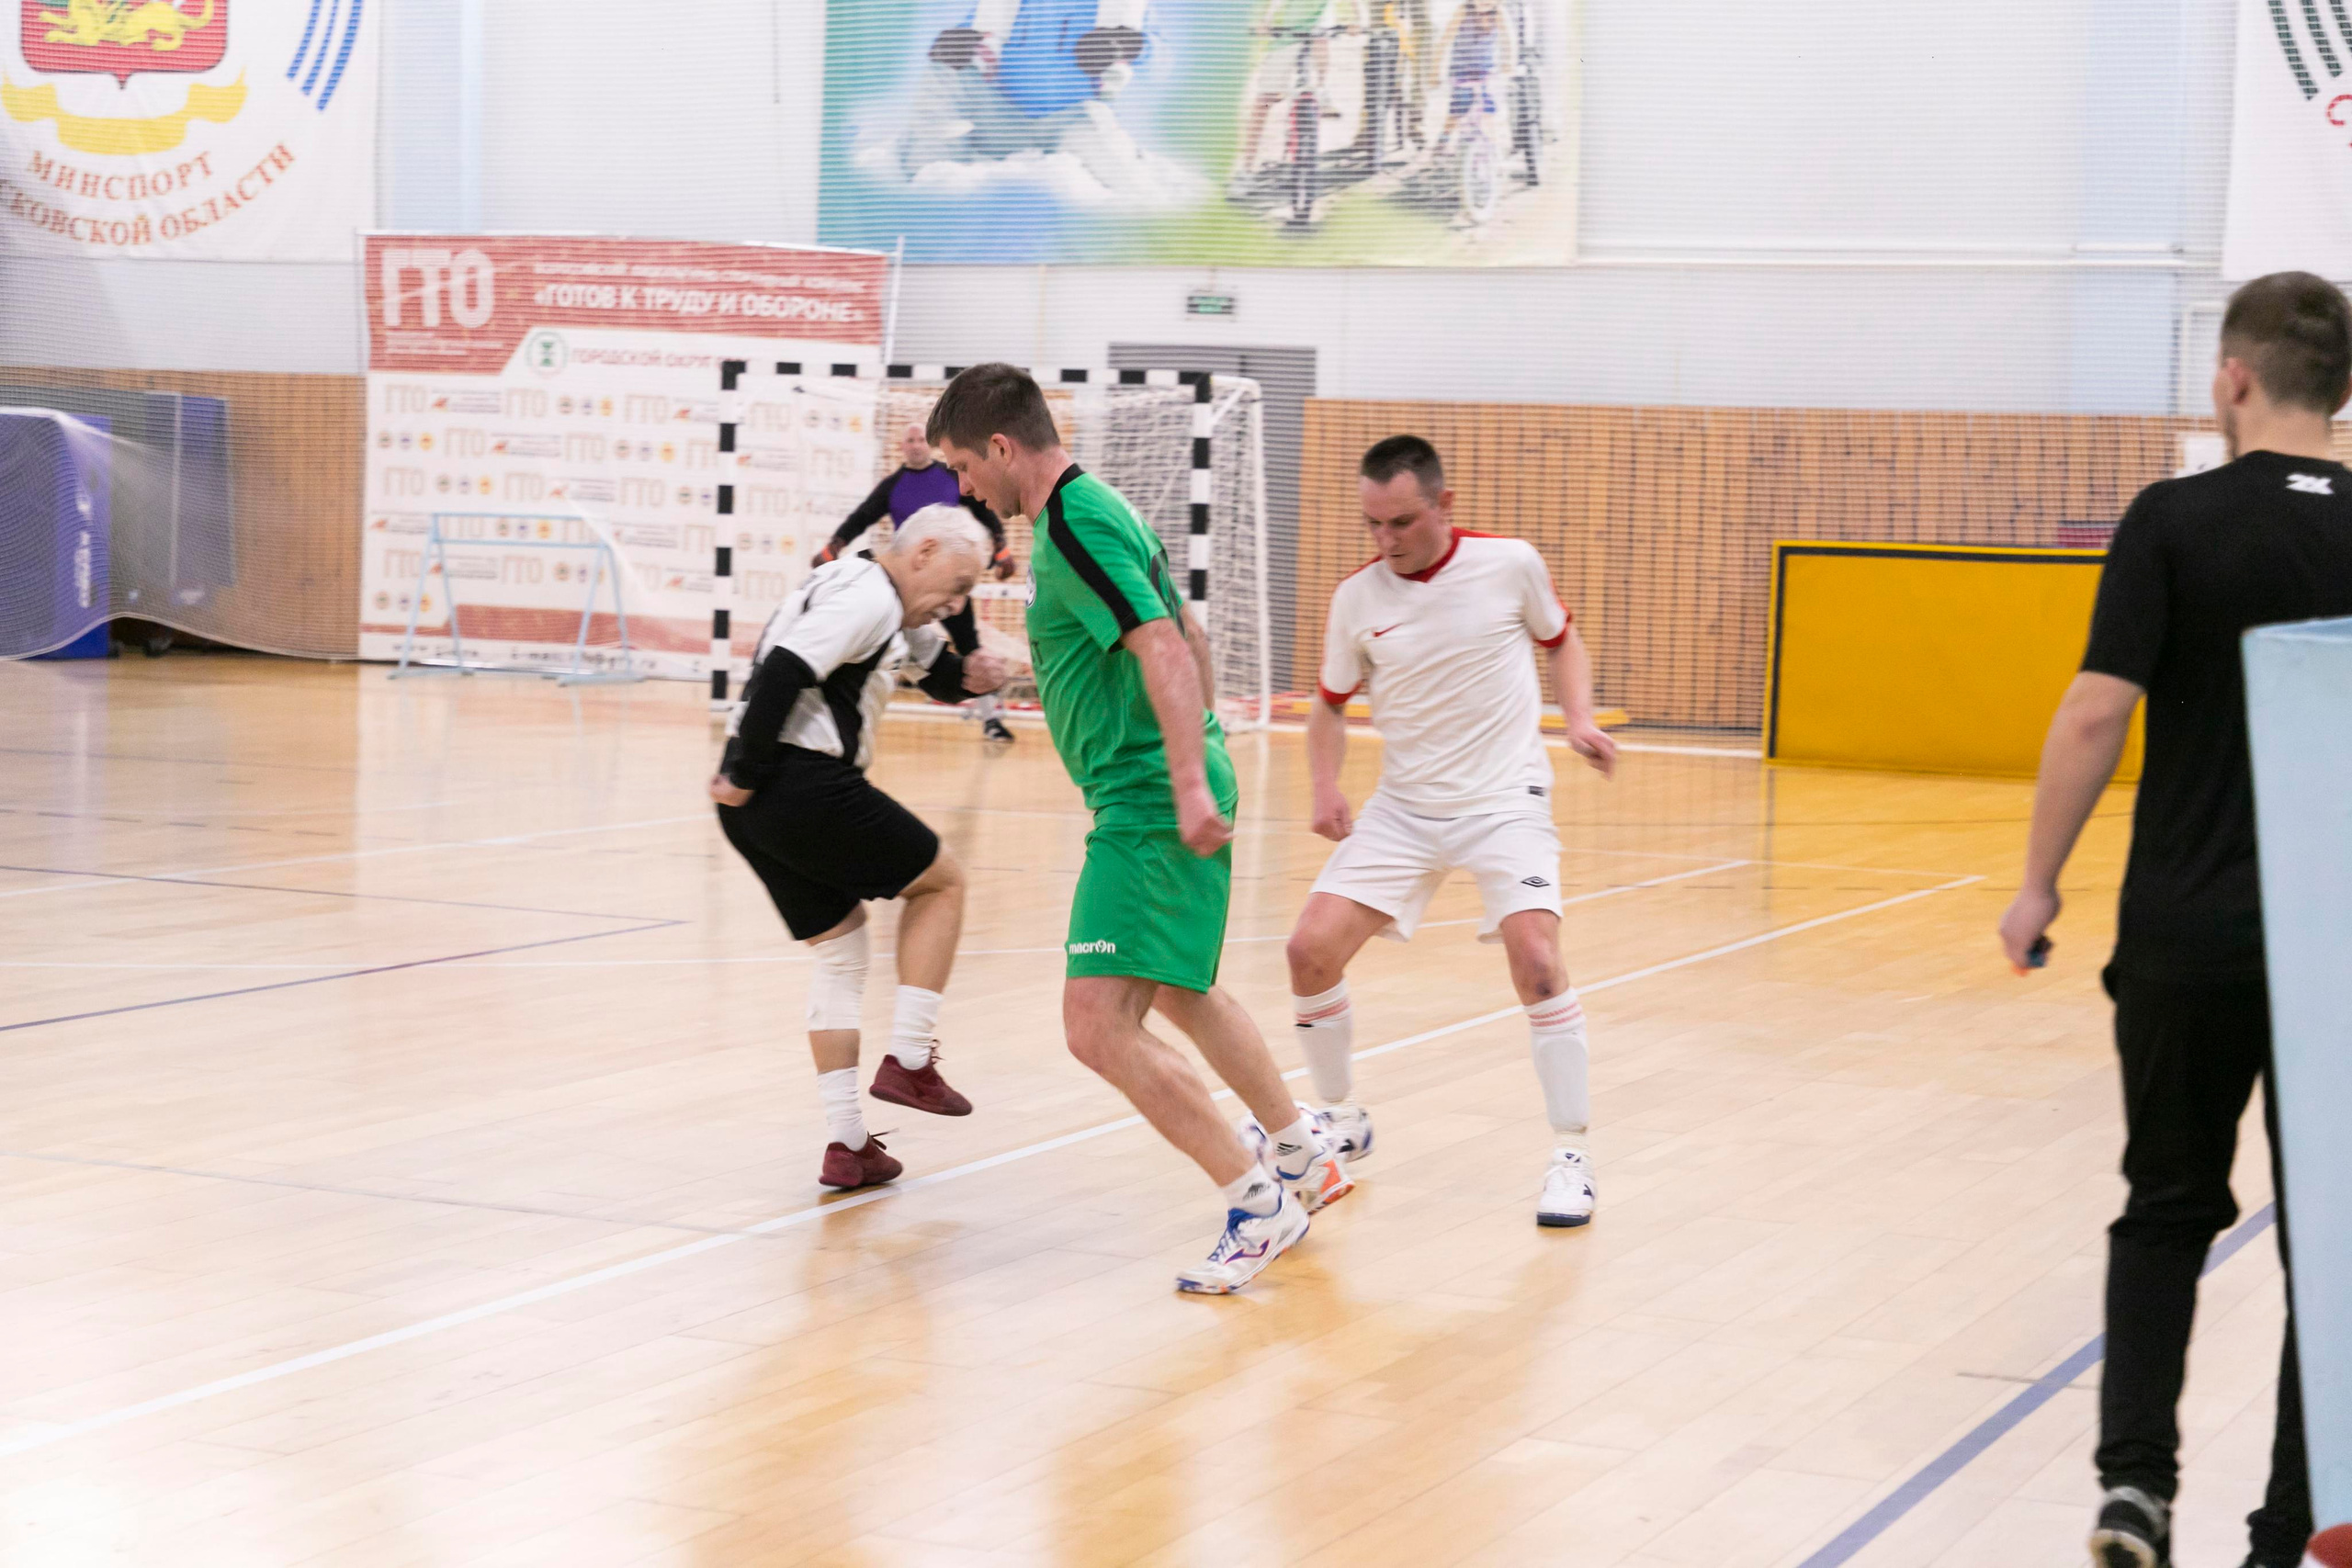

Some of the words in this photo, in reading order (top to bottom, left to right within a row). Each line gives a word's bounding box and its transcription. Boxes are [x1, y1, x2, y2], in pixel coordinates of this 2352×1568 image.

[28, 150, 212, 201] МИНСПОРТ
[160, 142, 295, 240] ОБЛАСТИ
[381, 249, 494, 328] ГТО
[620, 285, 637, 309] К
[642, 287, 715, 314] ТРУДУ
[718, 291, 737, 314] И
[1069, 939, 1116, 954] macron
